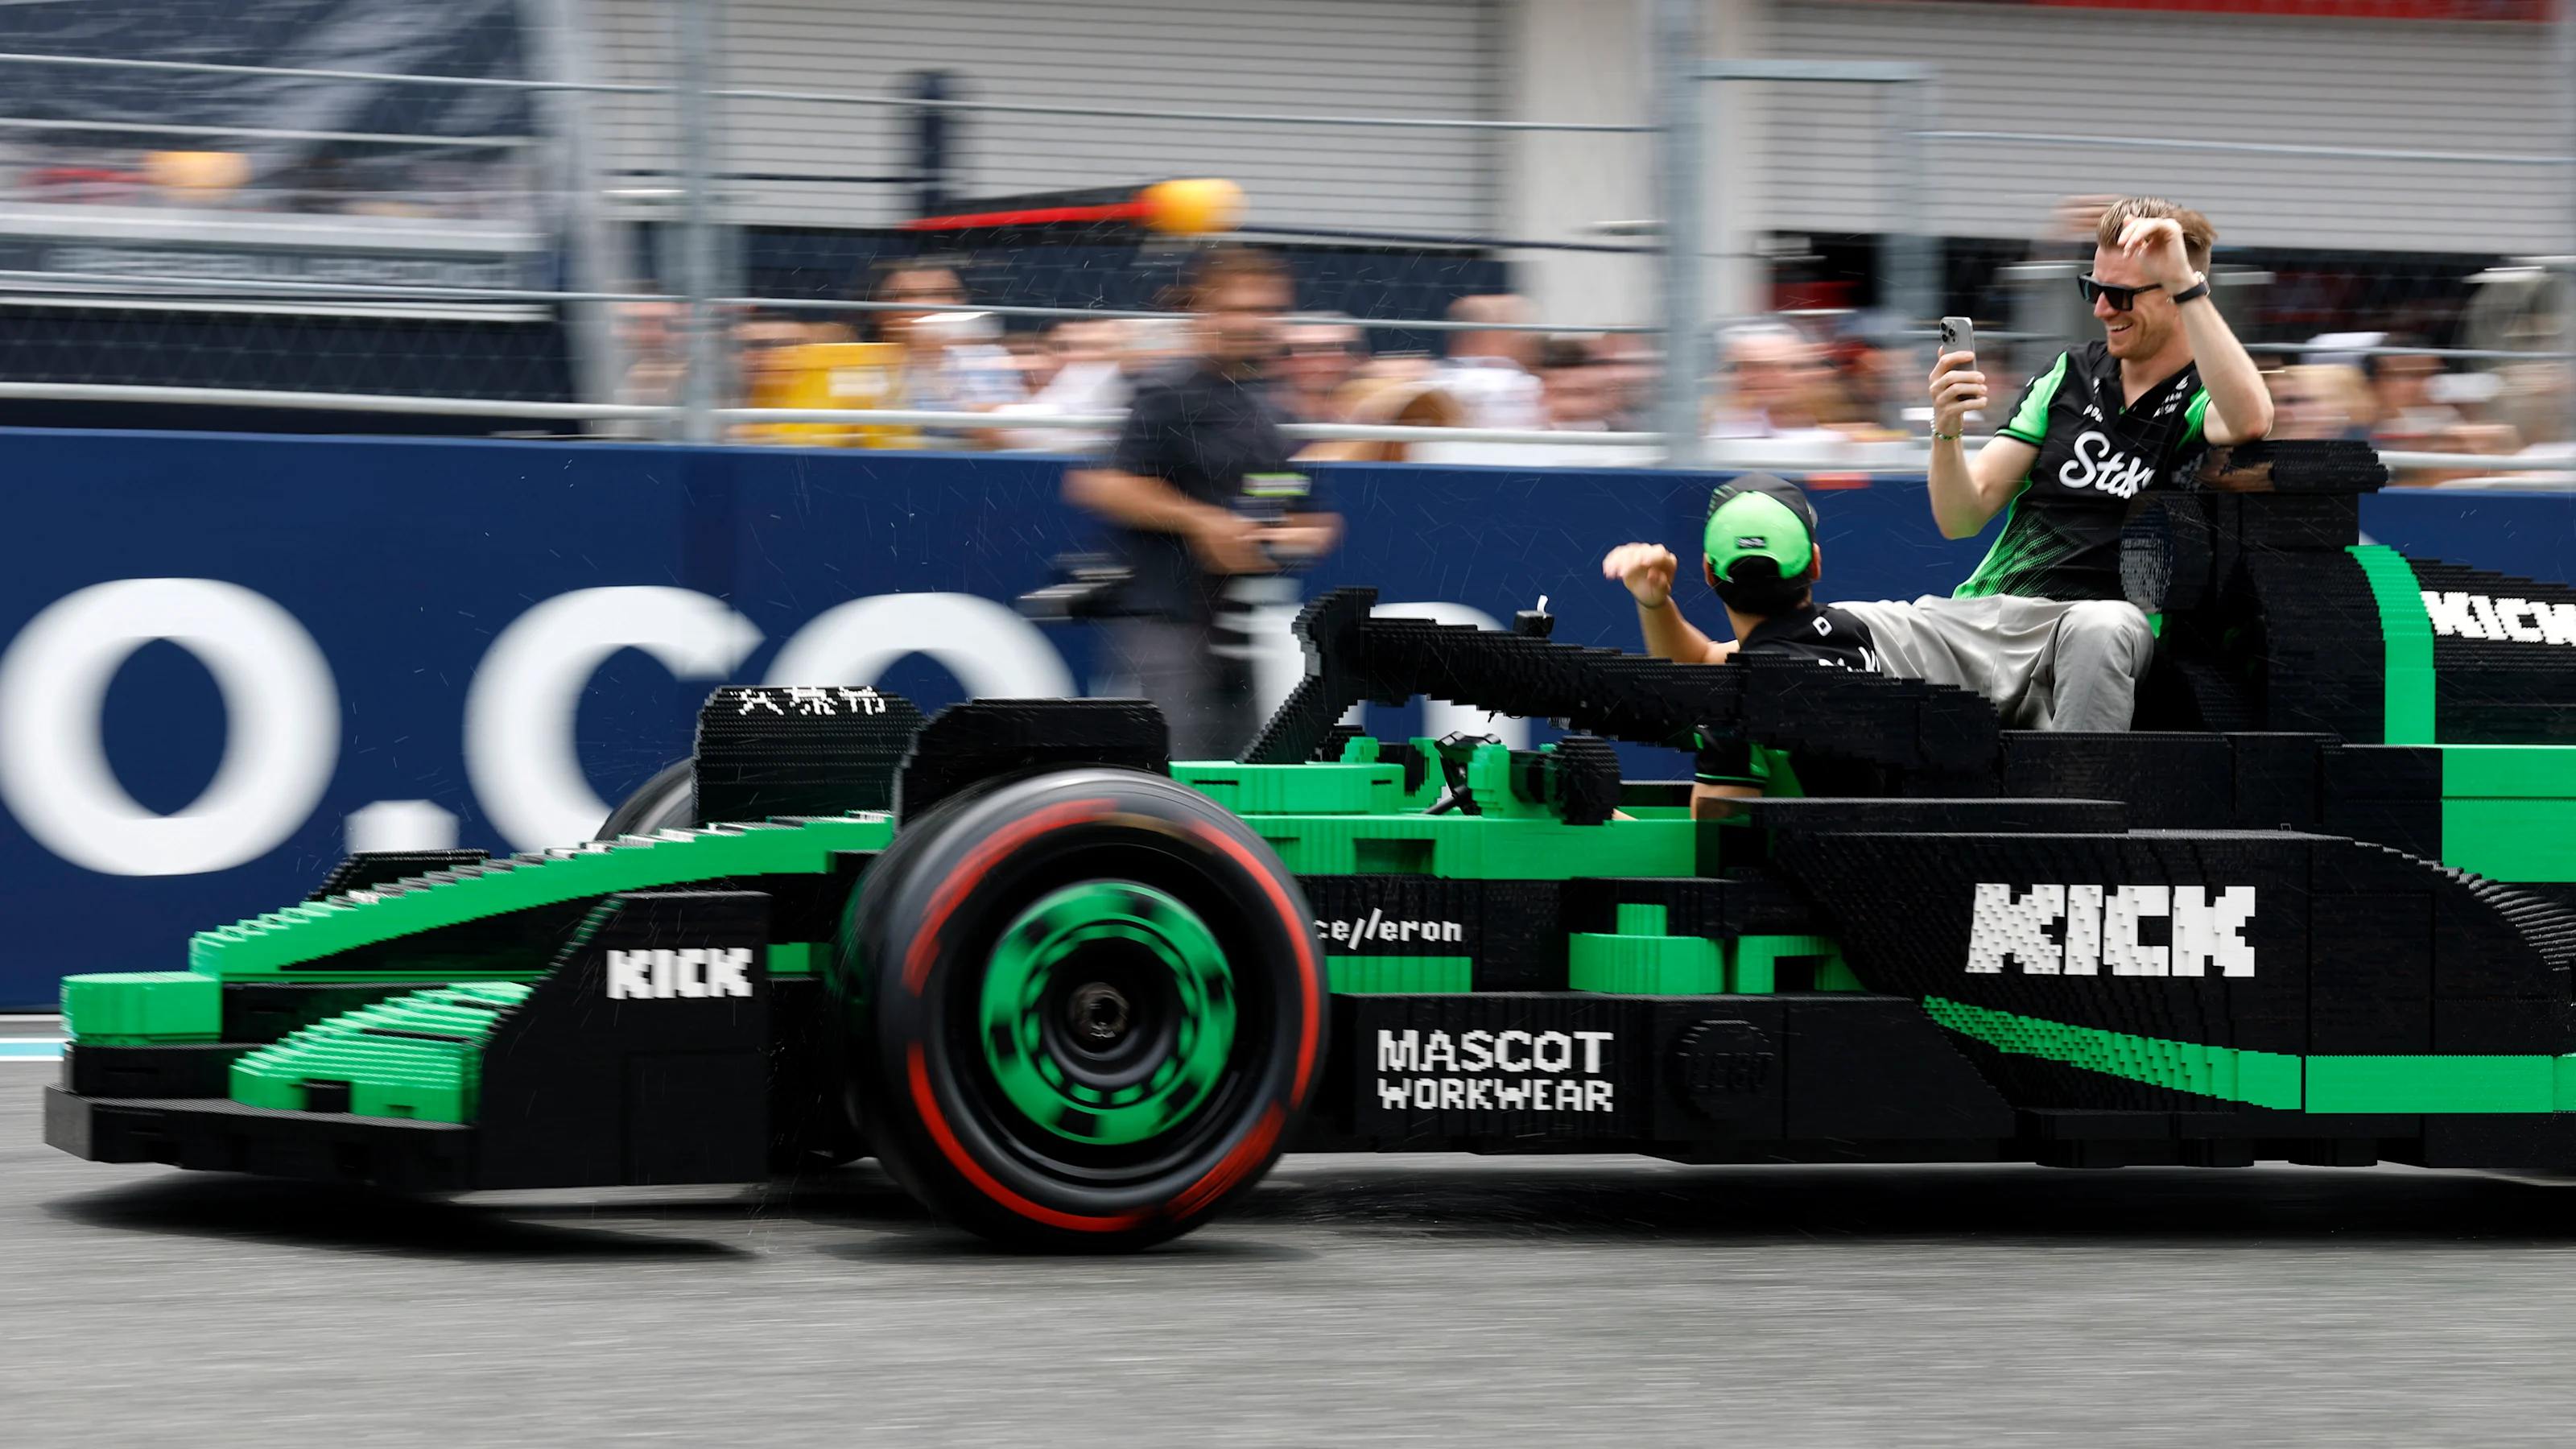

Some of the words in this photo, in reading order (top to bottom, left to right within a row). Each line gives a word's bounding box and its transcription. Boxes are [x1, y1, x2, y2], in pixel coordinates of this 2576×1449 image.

[2419, 591, 2576, 647] KICK
[1964, 883, 2256, 977] KICK
[607, 947, 753, 1000] KICK
[1377, 1030, 1614, 1073] MASCOT
[1377, 1078, 1613, 1112] WORKWEAR
